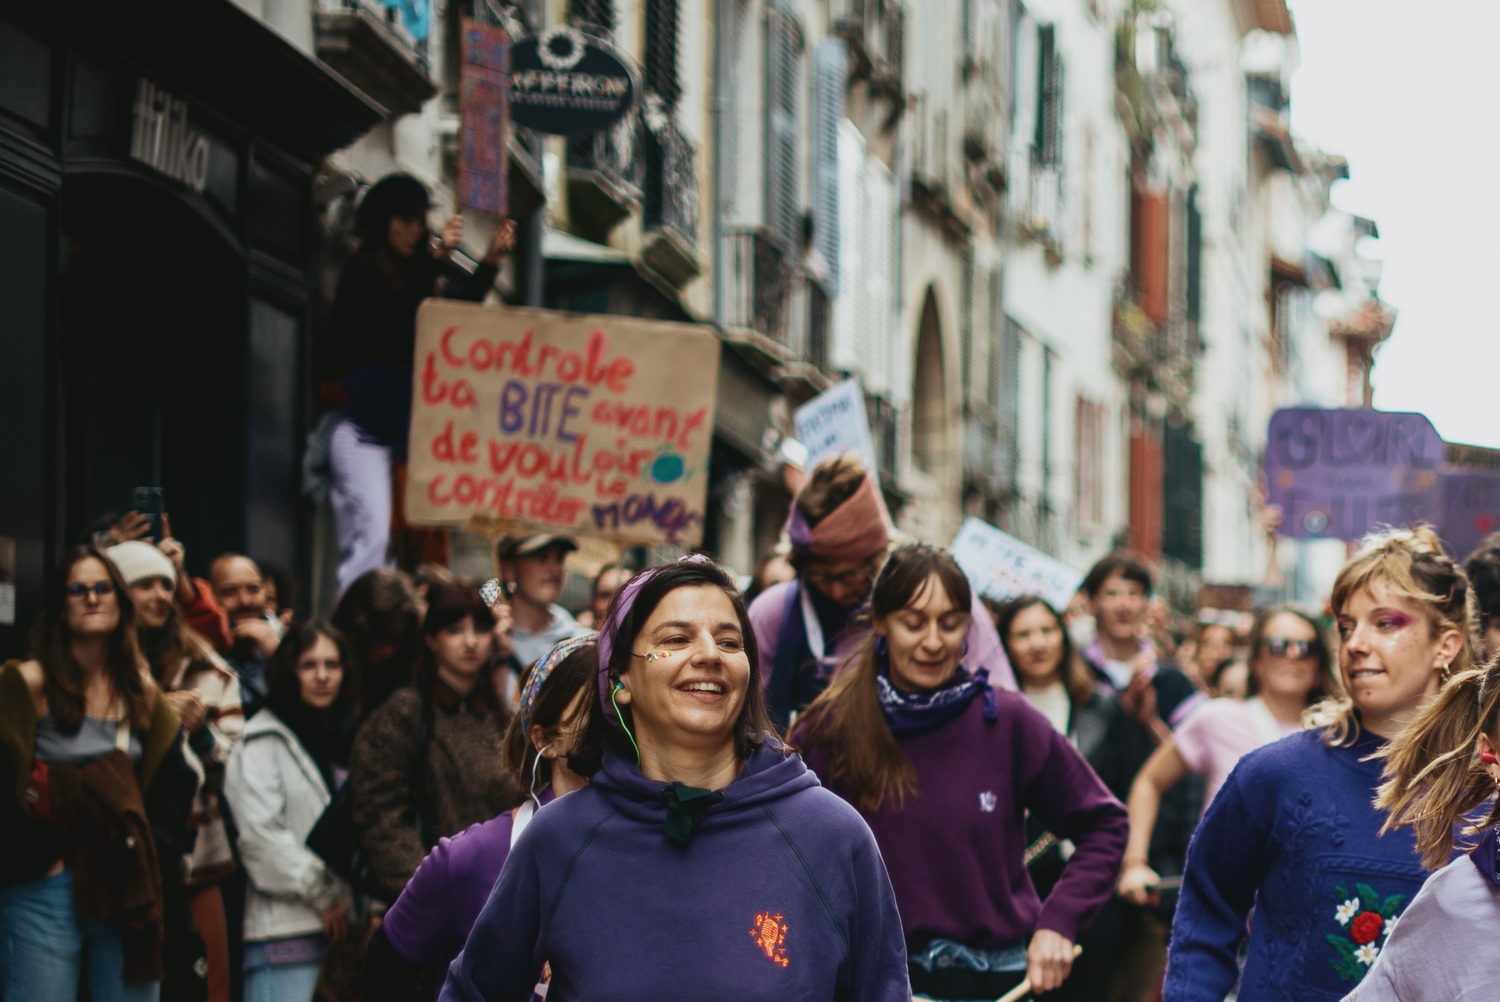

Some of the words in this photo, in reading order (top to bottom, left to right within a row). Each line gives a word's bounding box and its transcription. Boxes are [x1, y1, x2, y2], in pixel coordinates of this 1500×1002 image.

[499, 380, 590, 442] BITE
[591, 400, 708, 451] avant
[431, 420, 478, 464] de
[488, 433, 653, 484] vouloir
